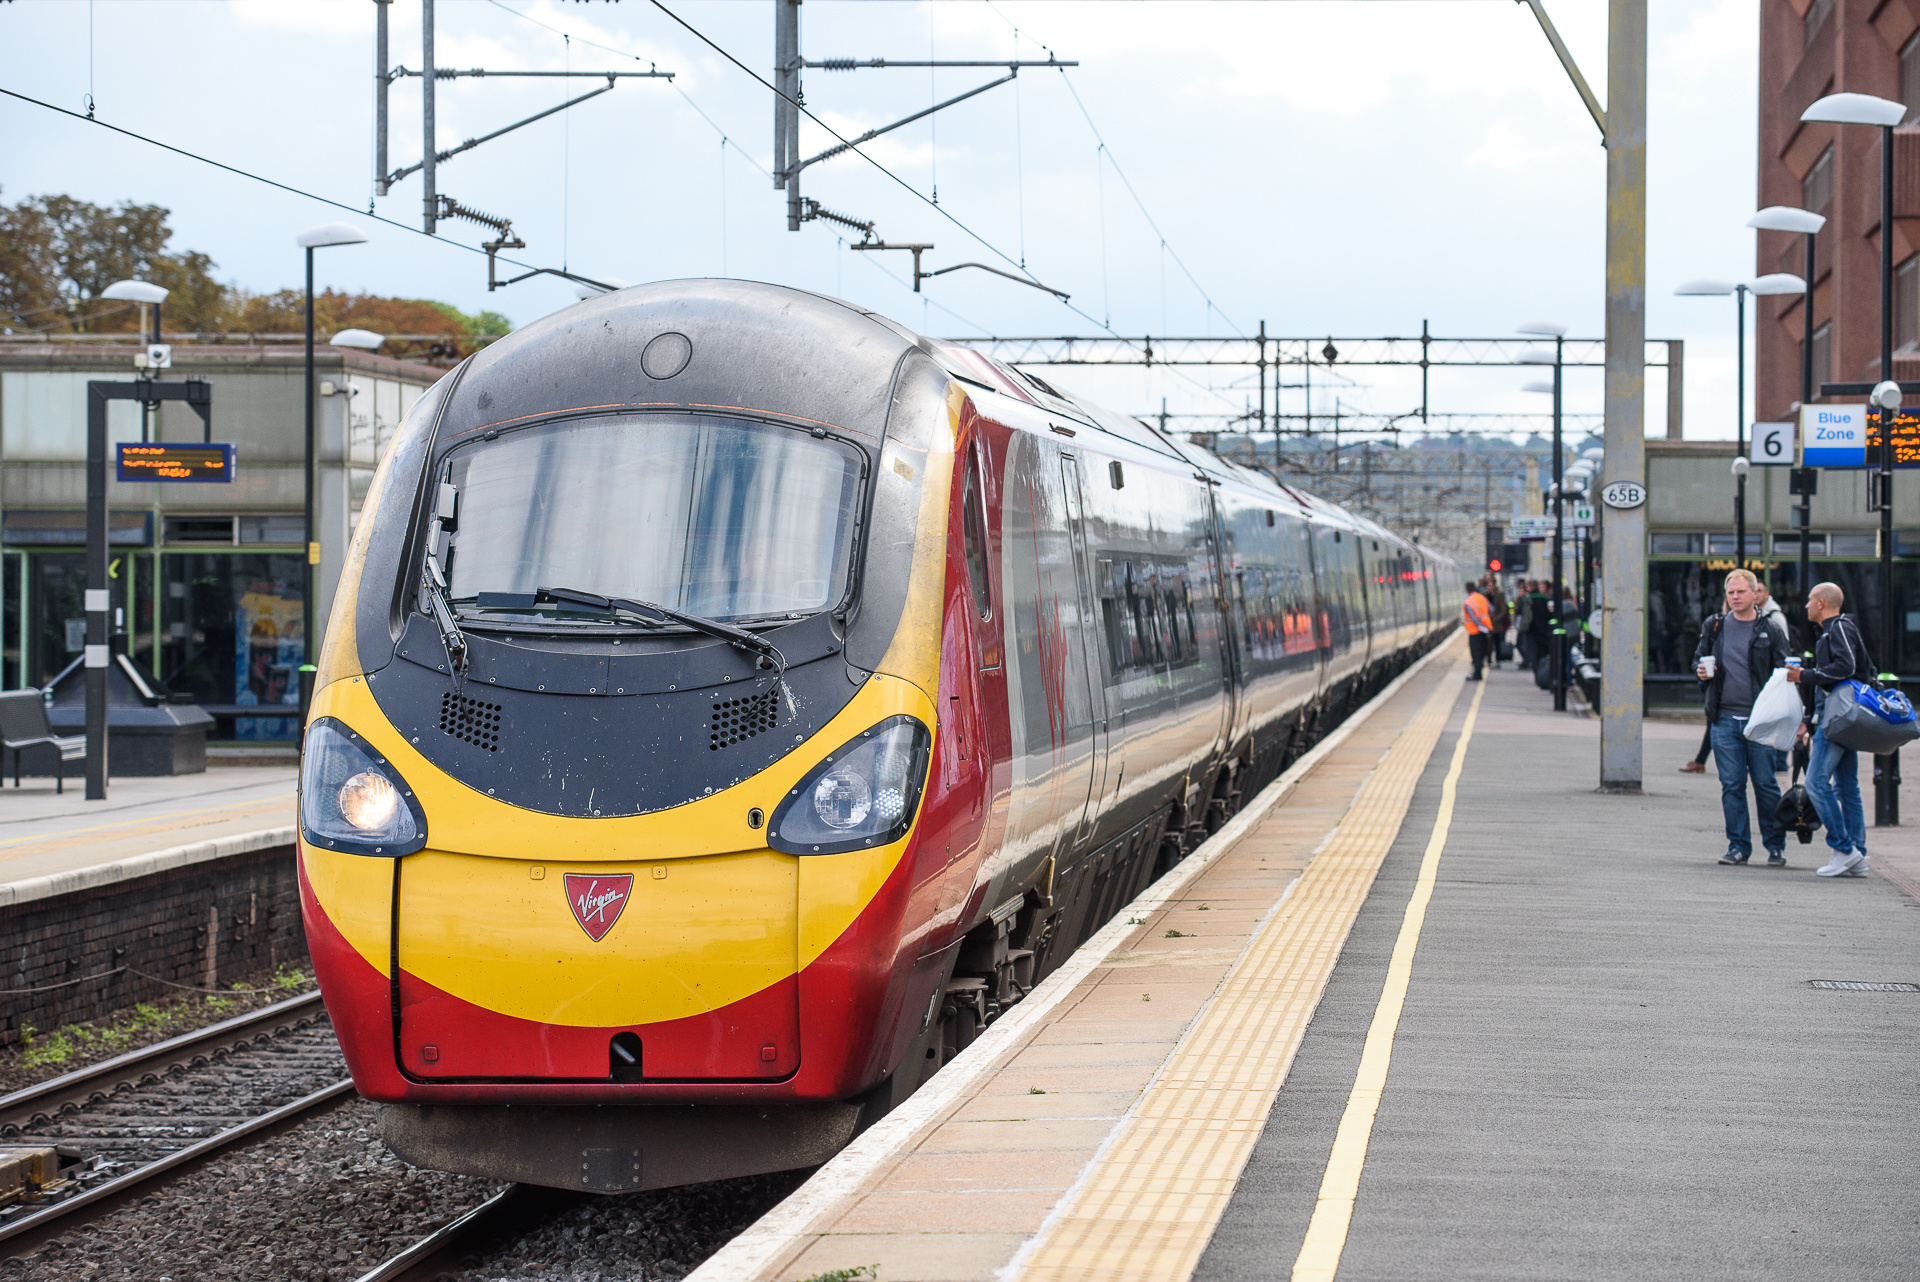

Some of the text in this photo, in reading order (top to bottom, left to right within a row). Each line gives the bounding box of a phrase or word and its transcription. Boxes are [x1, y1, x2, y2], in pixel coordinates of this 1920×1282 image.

[1818, 412, 1852, 424] Blue
[1816, 427, 1855, 440] Zone
[1764, 430, 1782, 457] 6
[1608, 488, 1640, 502] 65B
[577, 879, 624, 923] Virgin
